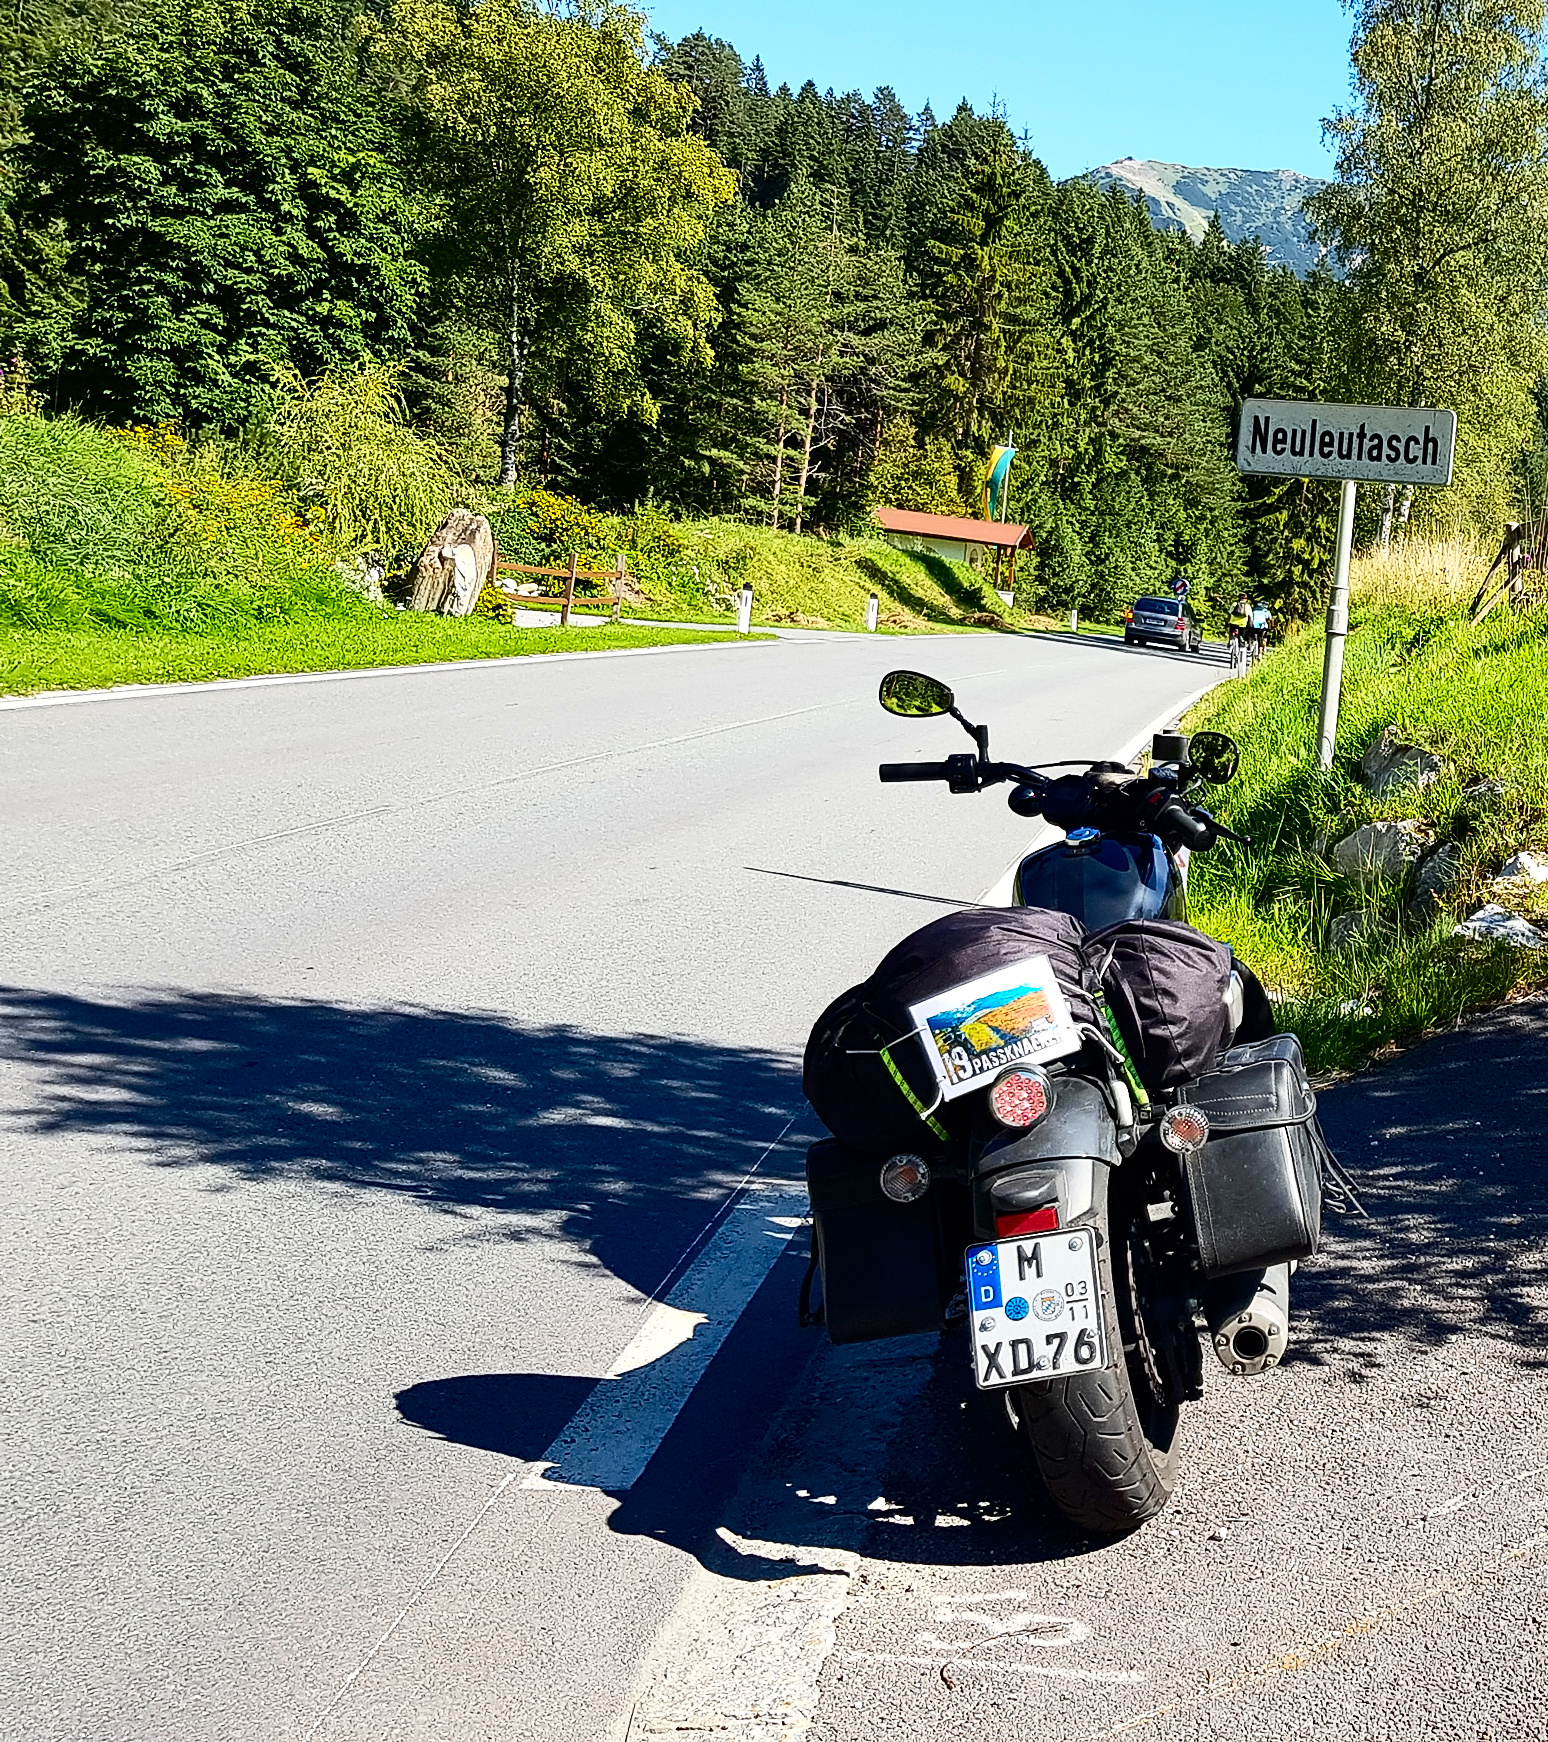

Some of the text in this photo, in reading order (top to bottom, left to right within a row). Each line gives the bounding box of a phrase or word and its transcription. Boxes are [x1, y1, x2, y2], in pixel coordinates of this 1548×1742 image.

[1250, 414, 1439, 466] Neuleutasch
[942, 1046, 973, 1084] 19
[1016, 1241, 1044, 1281] M
[980, 1286, 994, 1302] D
[1064, 1280, 1088, 1297] 03
[1069, 1304, 1089, 1321] 11
